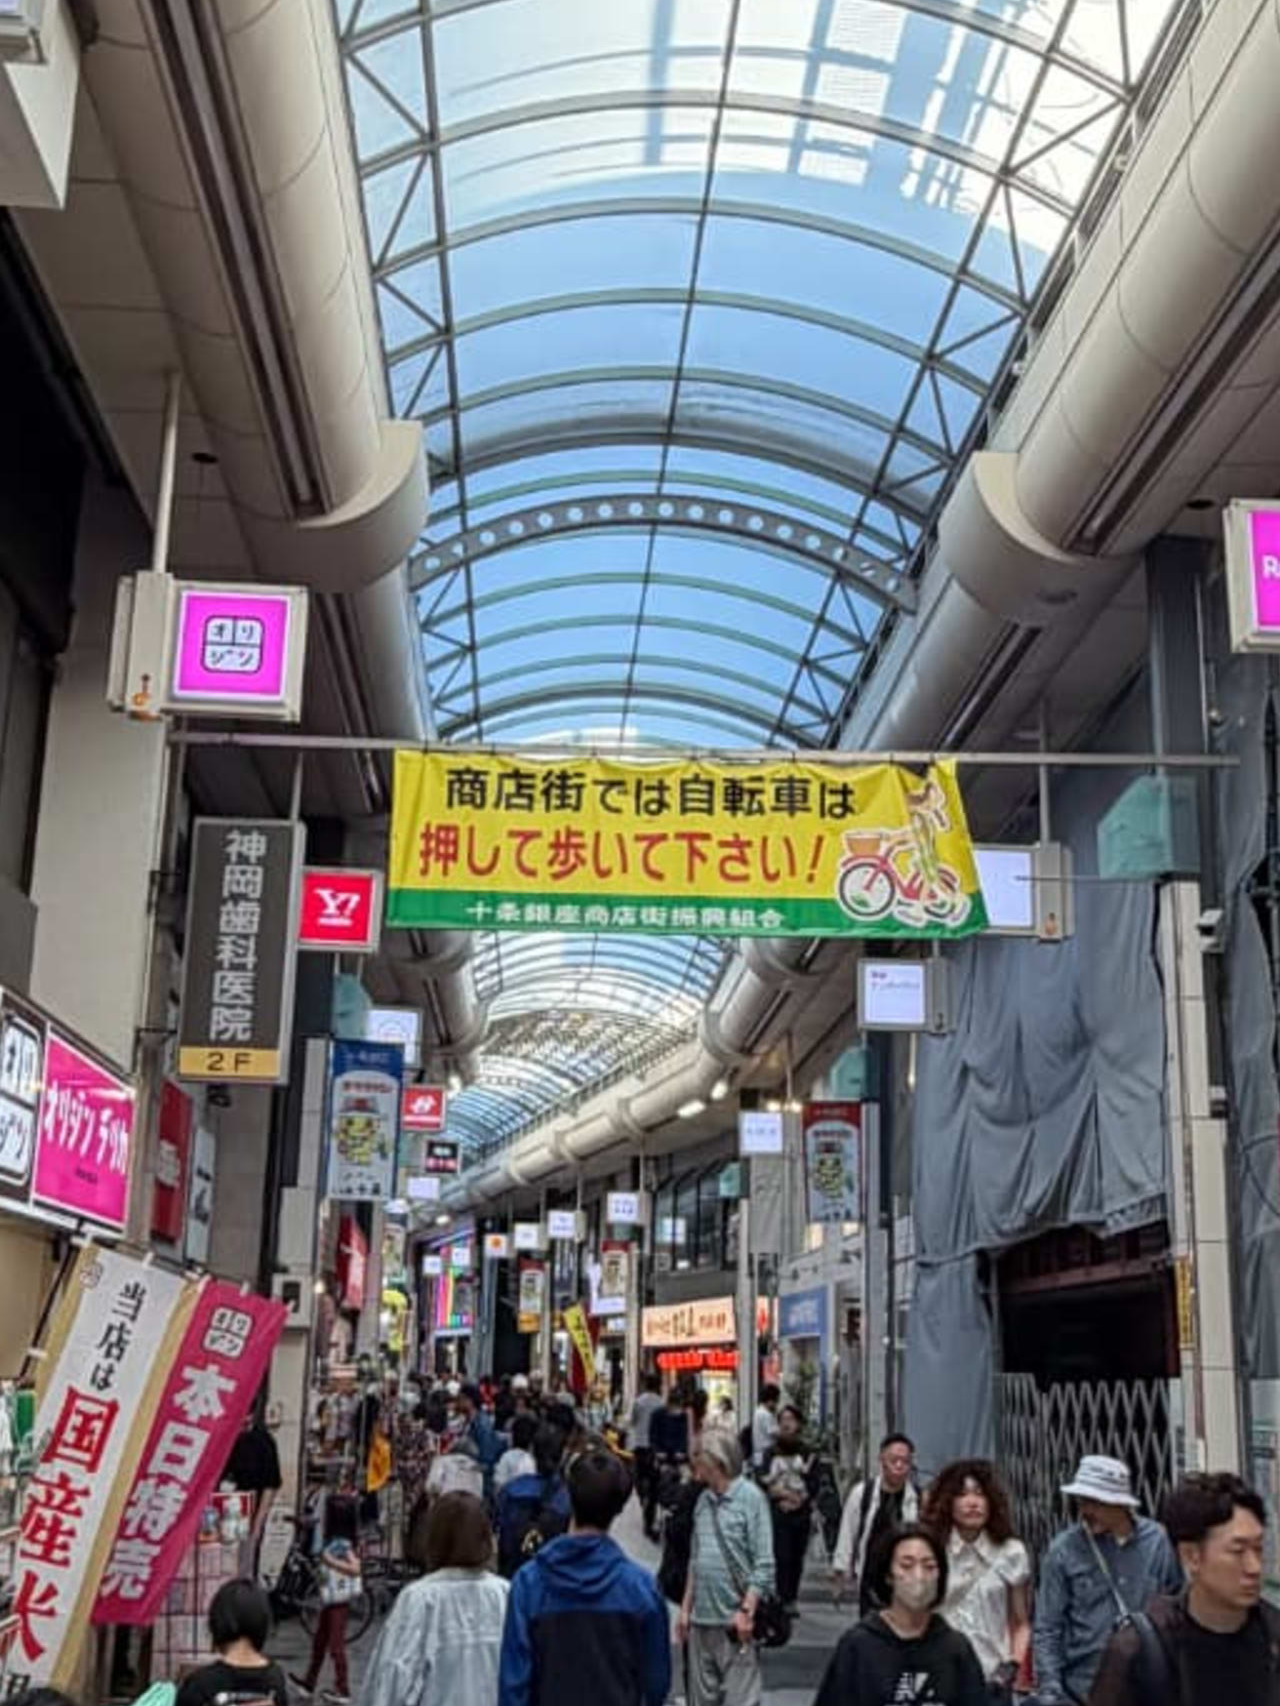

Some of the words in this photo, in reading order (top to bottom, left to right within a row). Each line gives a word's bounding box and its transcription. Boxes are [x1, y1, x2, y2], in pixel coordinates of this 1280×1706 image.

[446, 767, 856, 819] 商店街では自転車は
[418, 821, 824, 885] 押して歩いて下さい!
[465, 900, 786, 929] 十条銀座商店街振興組合
[206, 1051, 252, 1073] 2F
